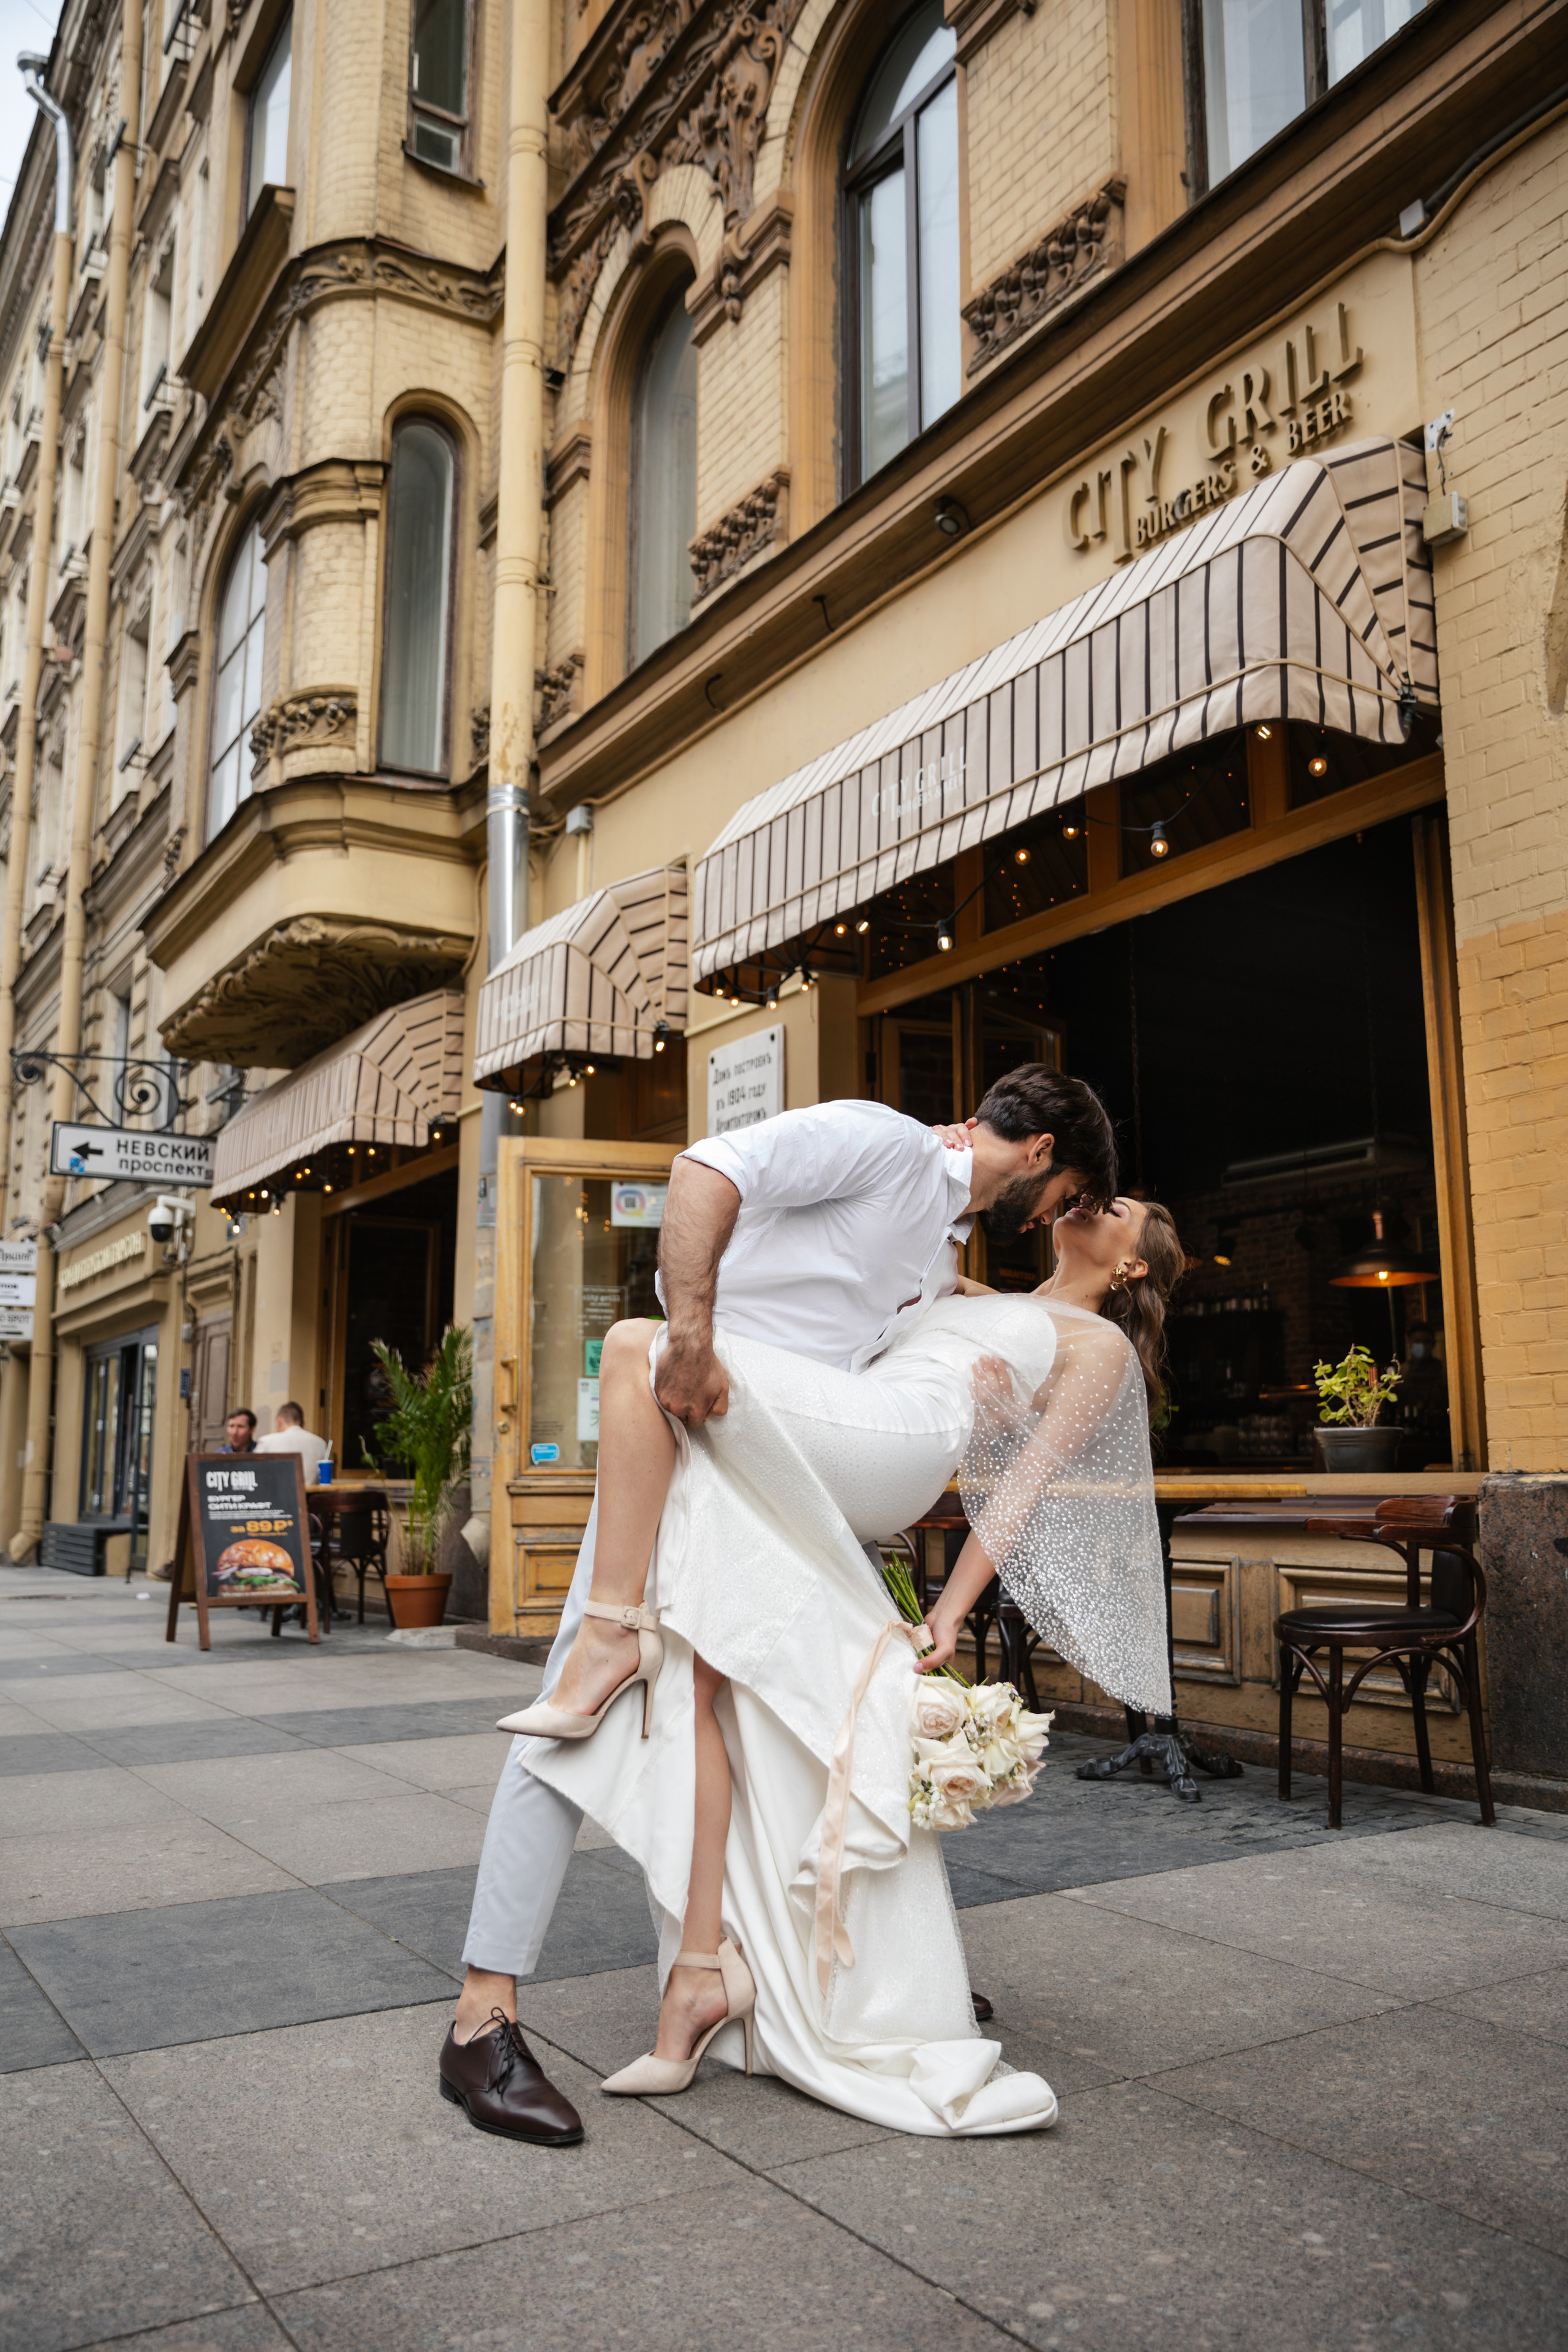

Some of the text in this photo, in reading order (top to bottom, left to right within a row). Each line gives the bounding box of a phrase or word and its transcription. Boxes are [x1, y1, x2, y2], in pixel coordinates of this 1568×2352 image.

[1062, 302, 1363, 565] CITY GRILL
[1136, 390, 1354, 549] BURGERS & BEER
[871, 746, 967, 821] CITY GRILL
[116, 1139, 209, 1161] НЕВСКИЙ
[119, 1158, 205, 1175] проспект
[206, 1471, 258, 1492] CITY GRILL
